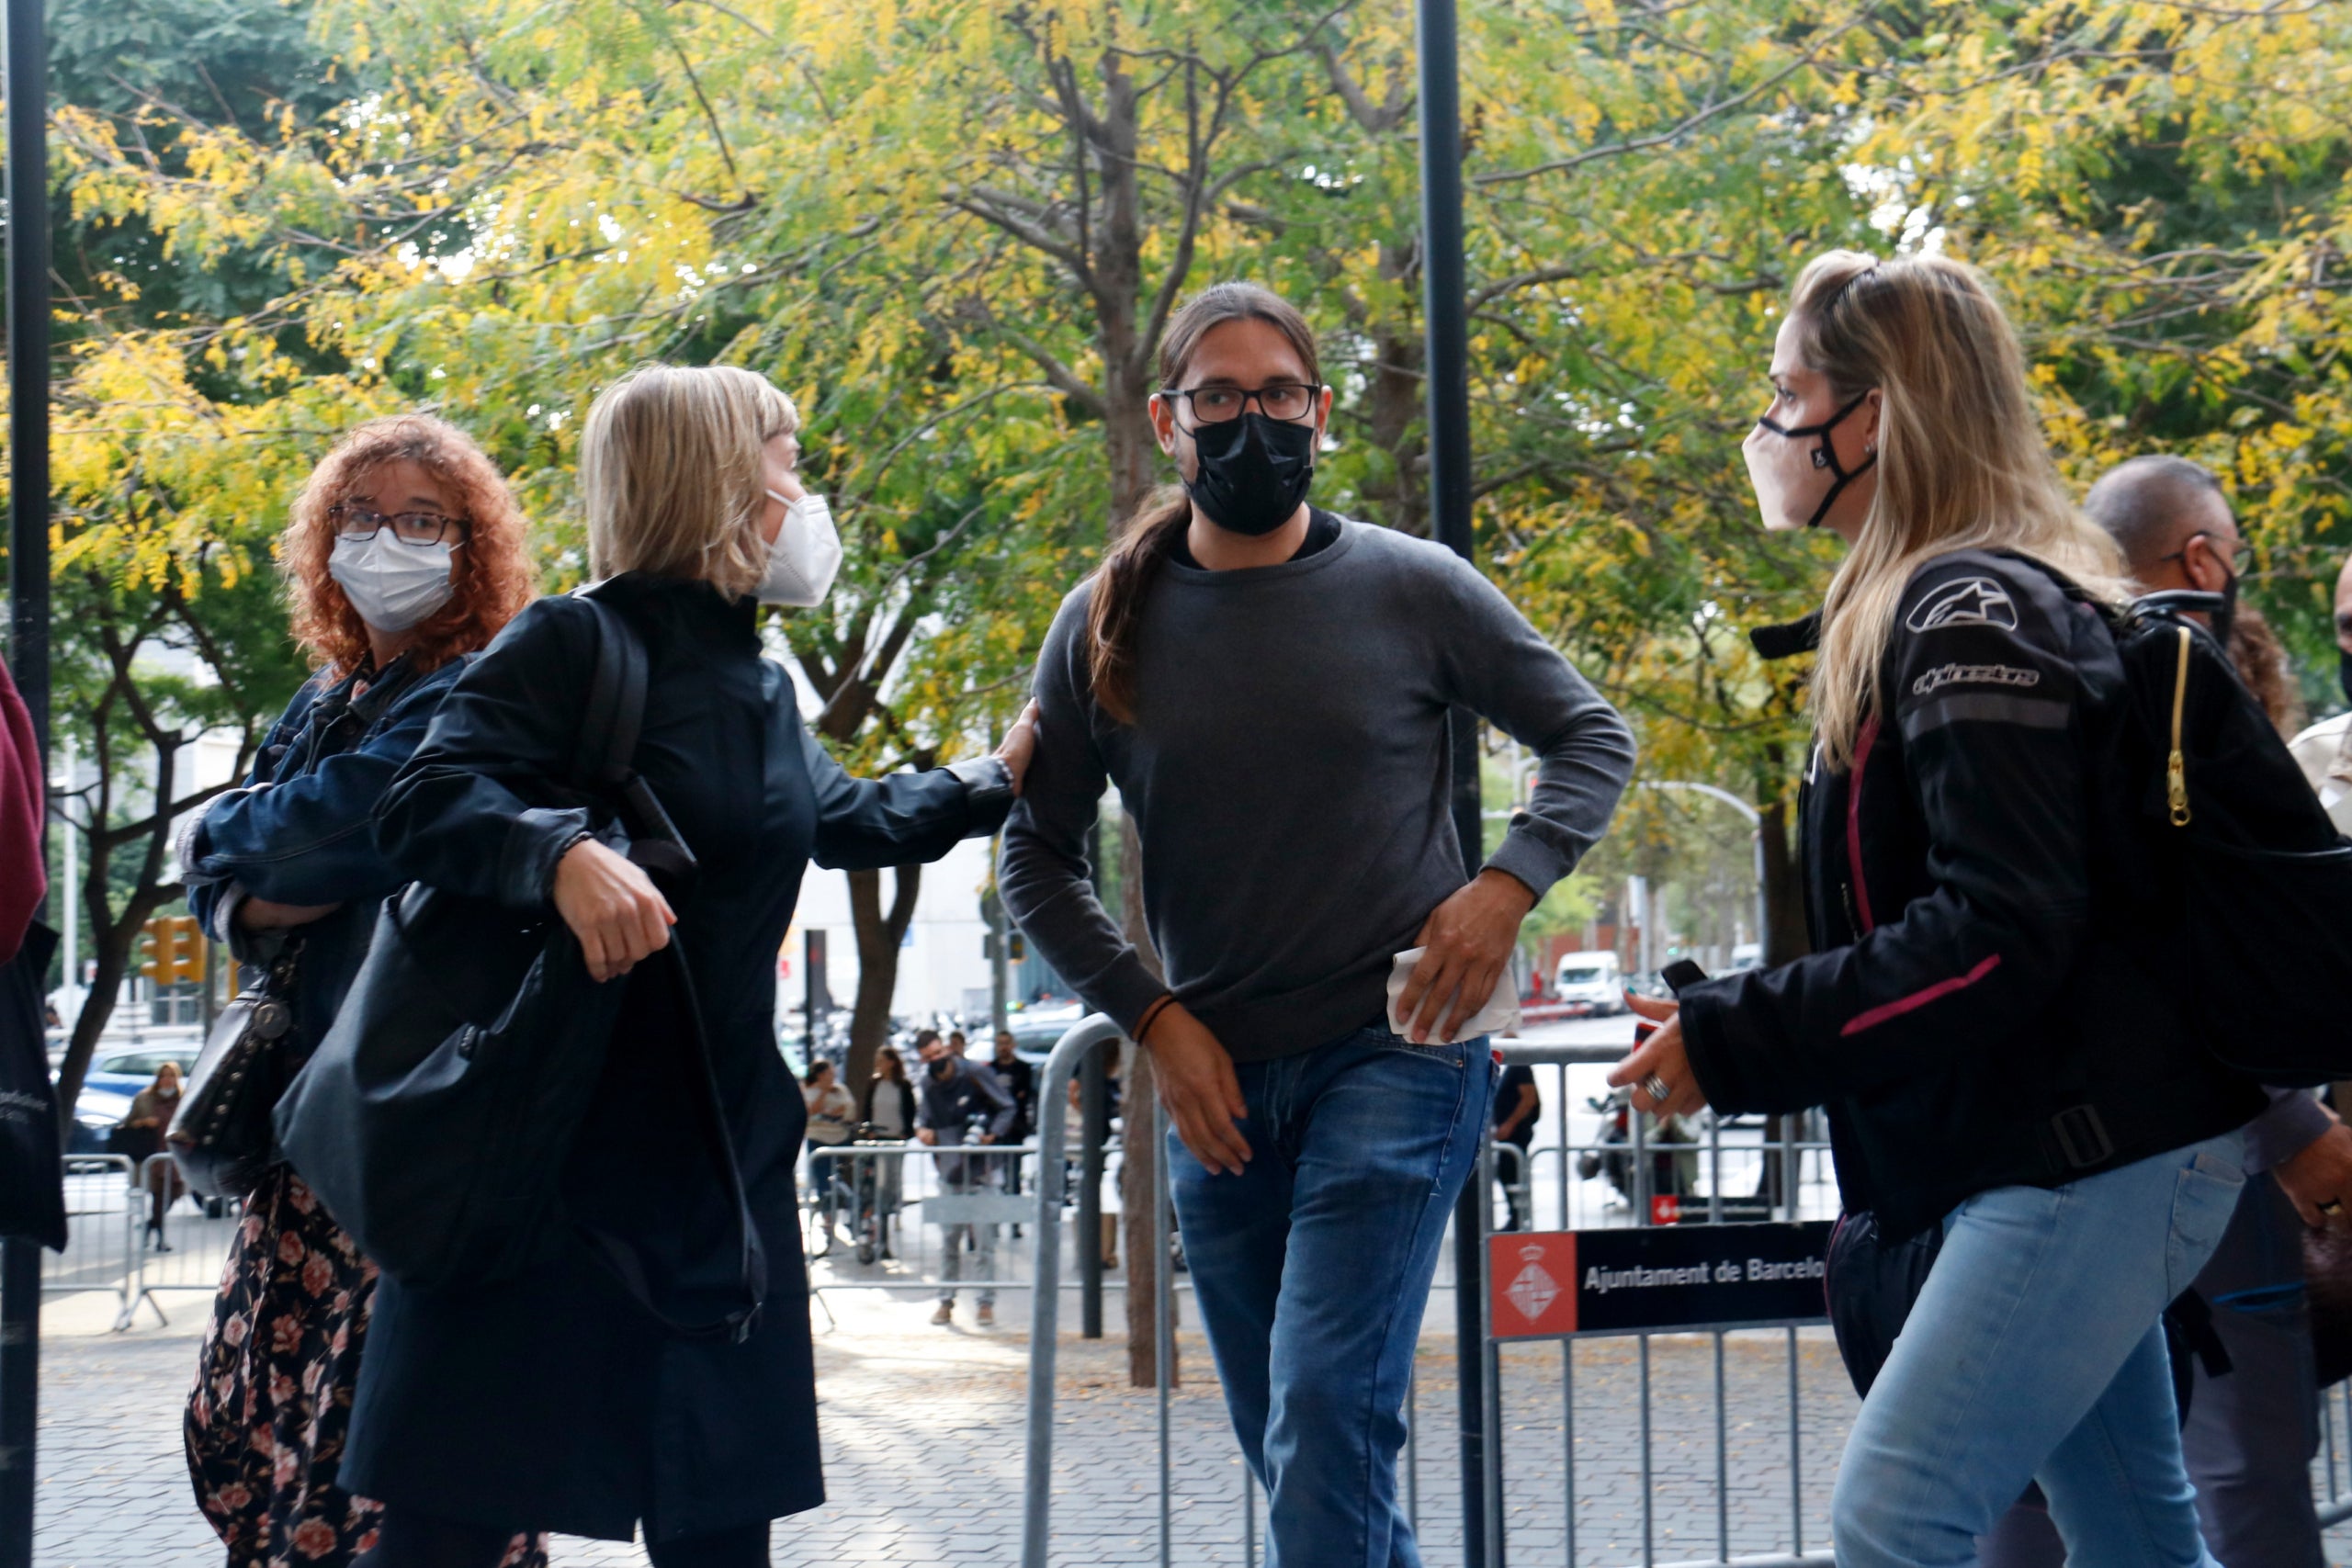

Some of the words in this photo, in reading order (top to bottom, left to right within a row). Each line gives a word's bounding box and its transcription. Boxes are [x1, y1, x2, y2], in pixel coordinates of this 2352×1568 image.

[1584, 1261, 1710, 1294] Ajuntament
[1714, 1259, 1742, 1283] de
[1747, 1256, 1826, 1281] Barcelo
